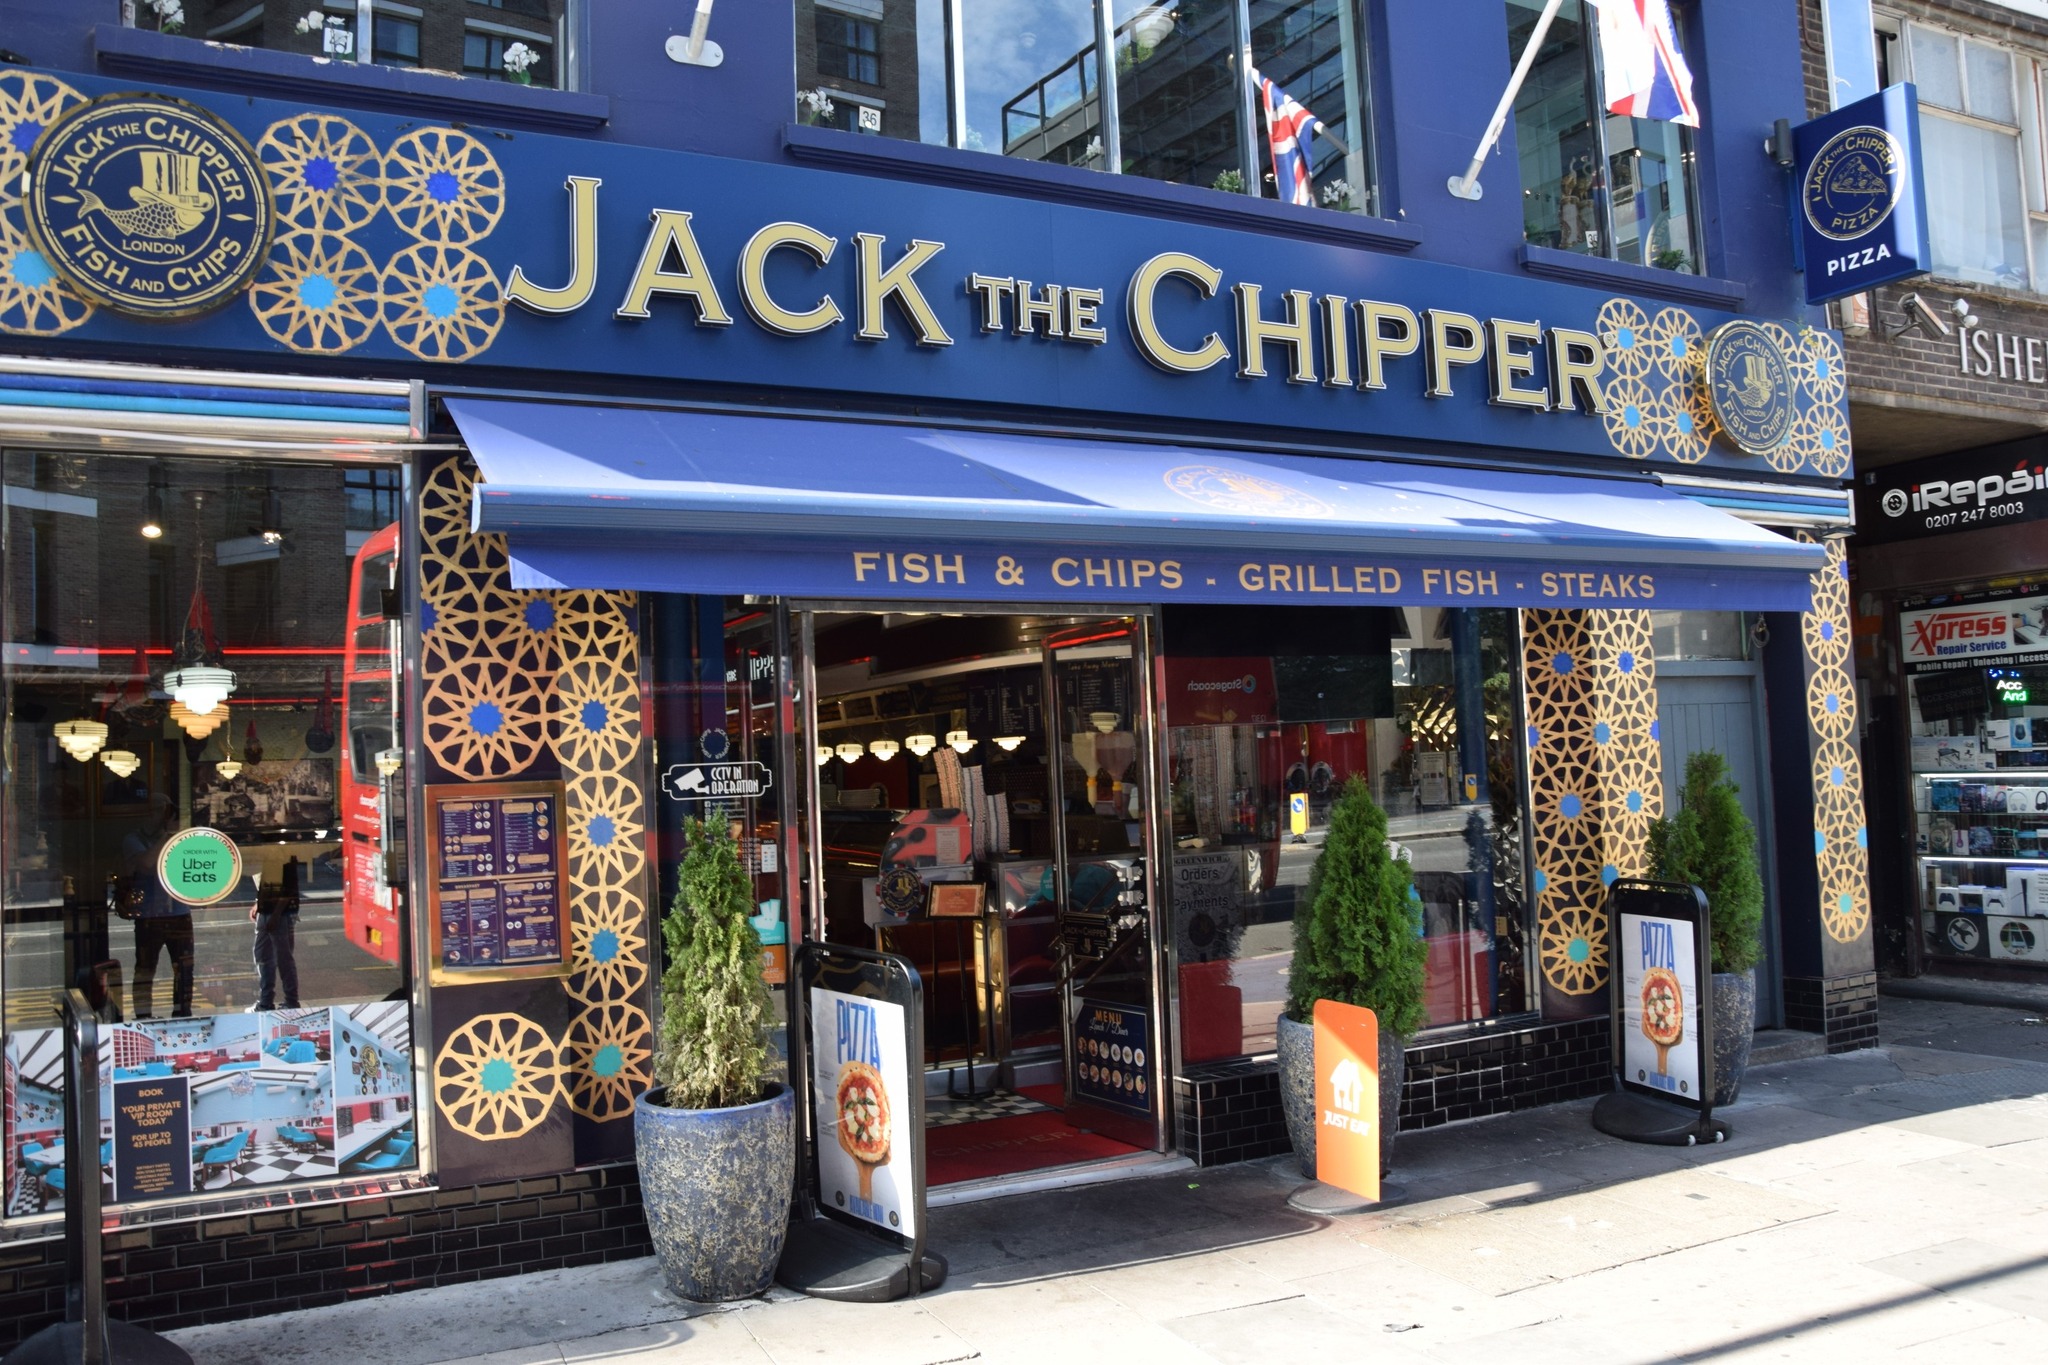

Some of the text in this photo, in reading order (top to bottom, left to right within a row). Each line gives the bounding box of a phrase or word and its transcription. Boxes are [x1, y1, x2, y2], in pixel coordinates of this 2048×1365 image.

[53, 117, 246, 204] JACK THE CHIPPER
[1810, 136, 1896, 193] JACK THE CHIPPER
[1831, 206, 1879, 230] PIZZA
[122, 239, 186, 256] LONDON
[61, 223, 242, 293] FISH AND CHIPS
[1827, 243, 1892, 277] PIZZA
[503, 175, 1611, 417] JACK THE CHIPPER
[1716, 342, 1738, 378] JACK
[1744, 335, 1785, 386] CHIPPER
[1958, 327, 2048, 384] ISHE
[1722, 401, 1748, 436] FISH
[1760, 406, 1786, 440] CHIPS
[1743, 409, 1766, 418] LONDON
[1925, 501, 2024, 529] 0207 247 8003
[853, 551, 966, 584] FISH
[995, 555, 1024, 585] &
[1051, 557, 1184, 590] CHIPS
[1238, 563, 1402, 594] GRILLED
[1422, 568, 1500, 596] FISH
[1541, 571, 1656, 599] STEAKS
[1989, 588, 2013, 596] NOKIA
[2029, 584, 2039, 592] LG
[1910, 612, 2007, 656] Xpress
[1937, 639, 2007, 655] Repair Service
[1916, 661, 1941, 672] Mobile
[1943, 659, 1968, 670] Repair
[1973, 655, 2013, 667] Unlocking
[2003, 690, 2027, 702] And
[710, 766, 742, 780] CCTV IN
[711, 780, 759, 795] OPERATION
[183, 858, 217, 870] Uber
[183, 871, 217, 883] Eats
[1181, 868, 1219, 881] Orders
[1641, 921, 1676, 975] PIZZA
[1095, 1009, 1122, 1025] MENU
[836, 999, 881, 1073] PIZZA
[138, 1088, 164, 1098] BOOK
[122, 1100, 181, 1114] YOUR PRIVATE
[130, 1109, 173, 1120] VIP ROOM
[137, 1117, 166, 1127] TODAY
[1323, 1109, 1370, 1137] JUST EAT
[132, 1134, 147, 1142] FOR
[160, 1131, 171, 1139] TO
[133, 1138, 172, 1149] 45 PEOPLE
[932, 1131, 1074, 1157] CHIPPER
